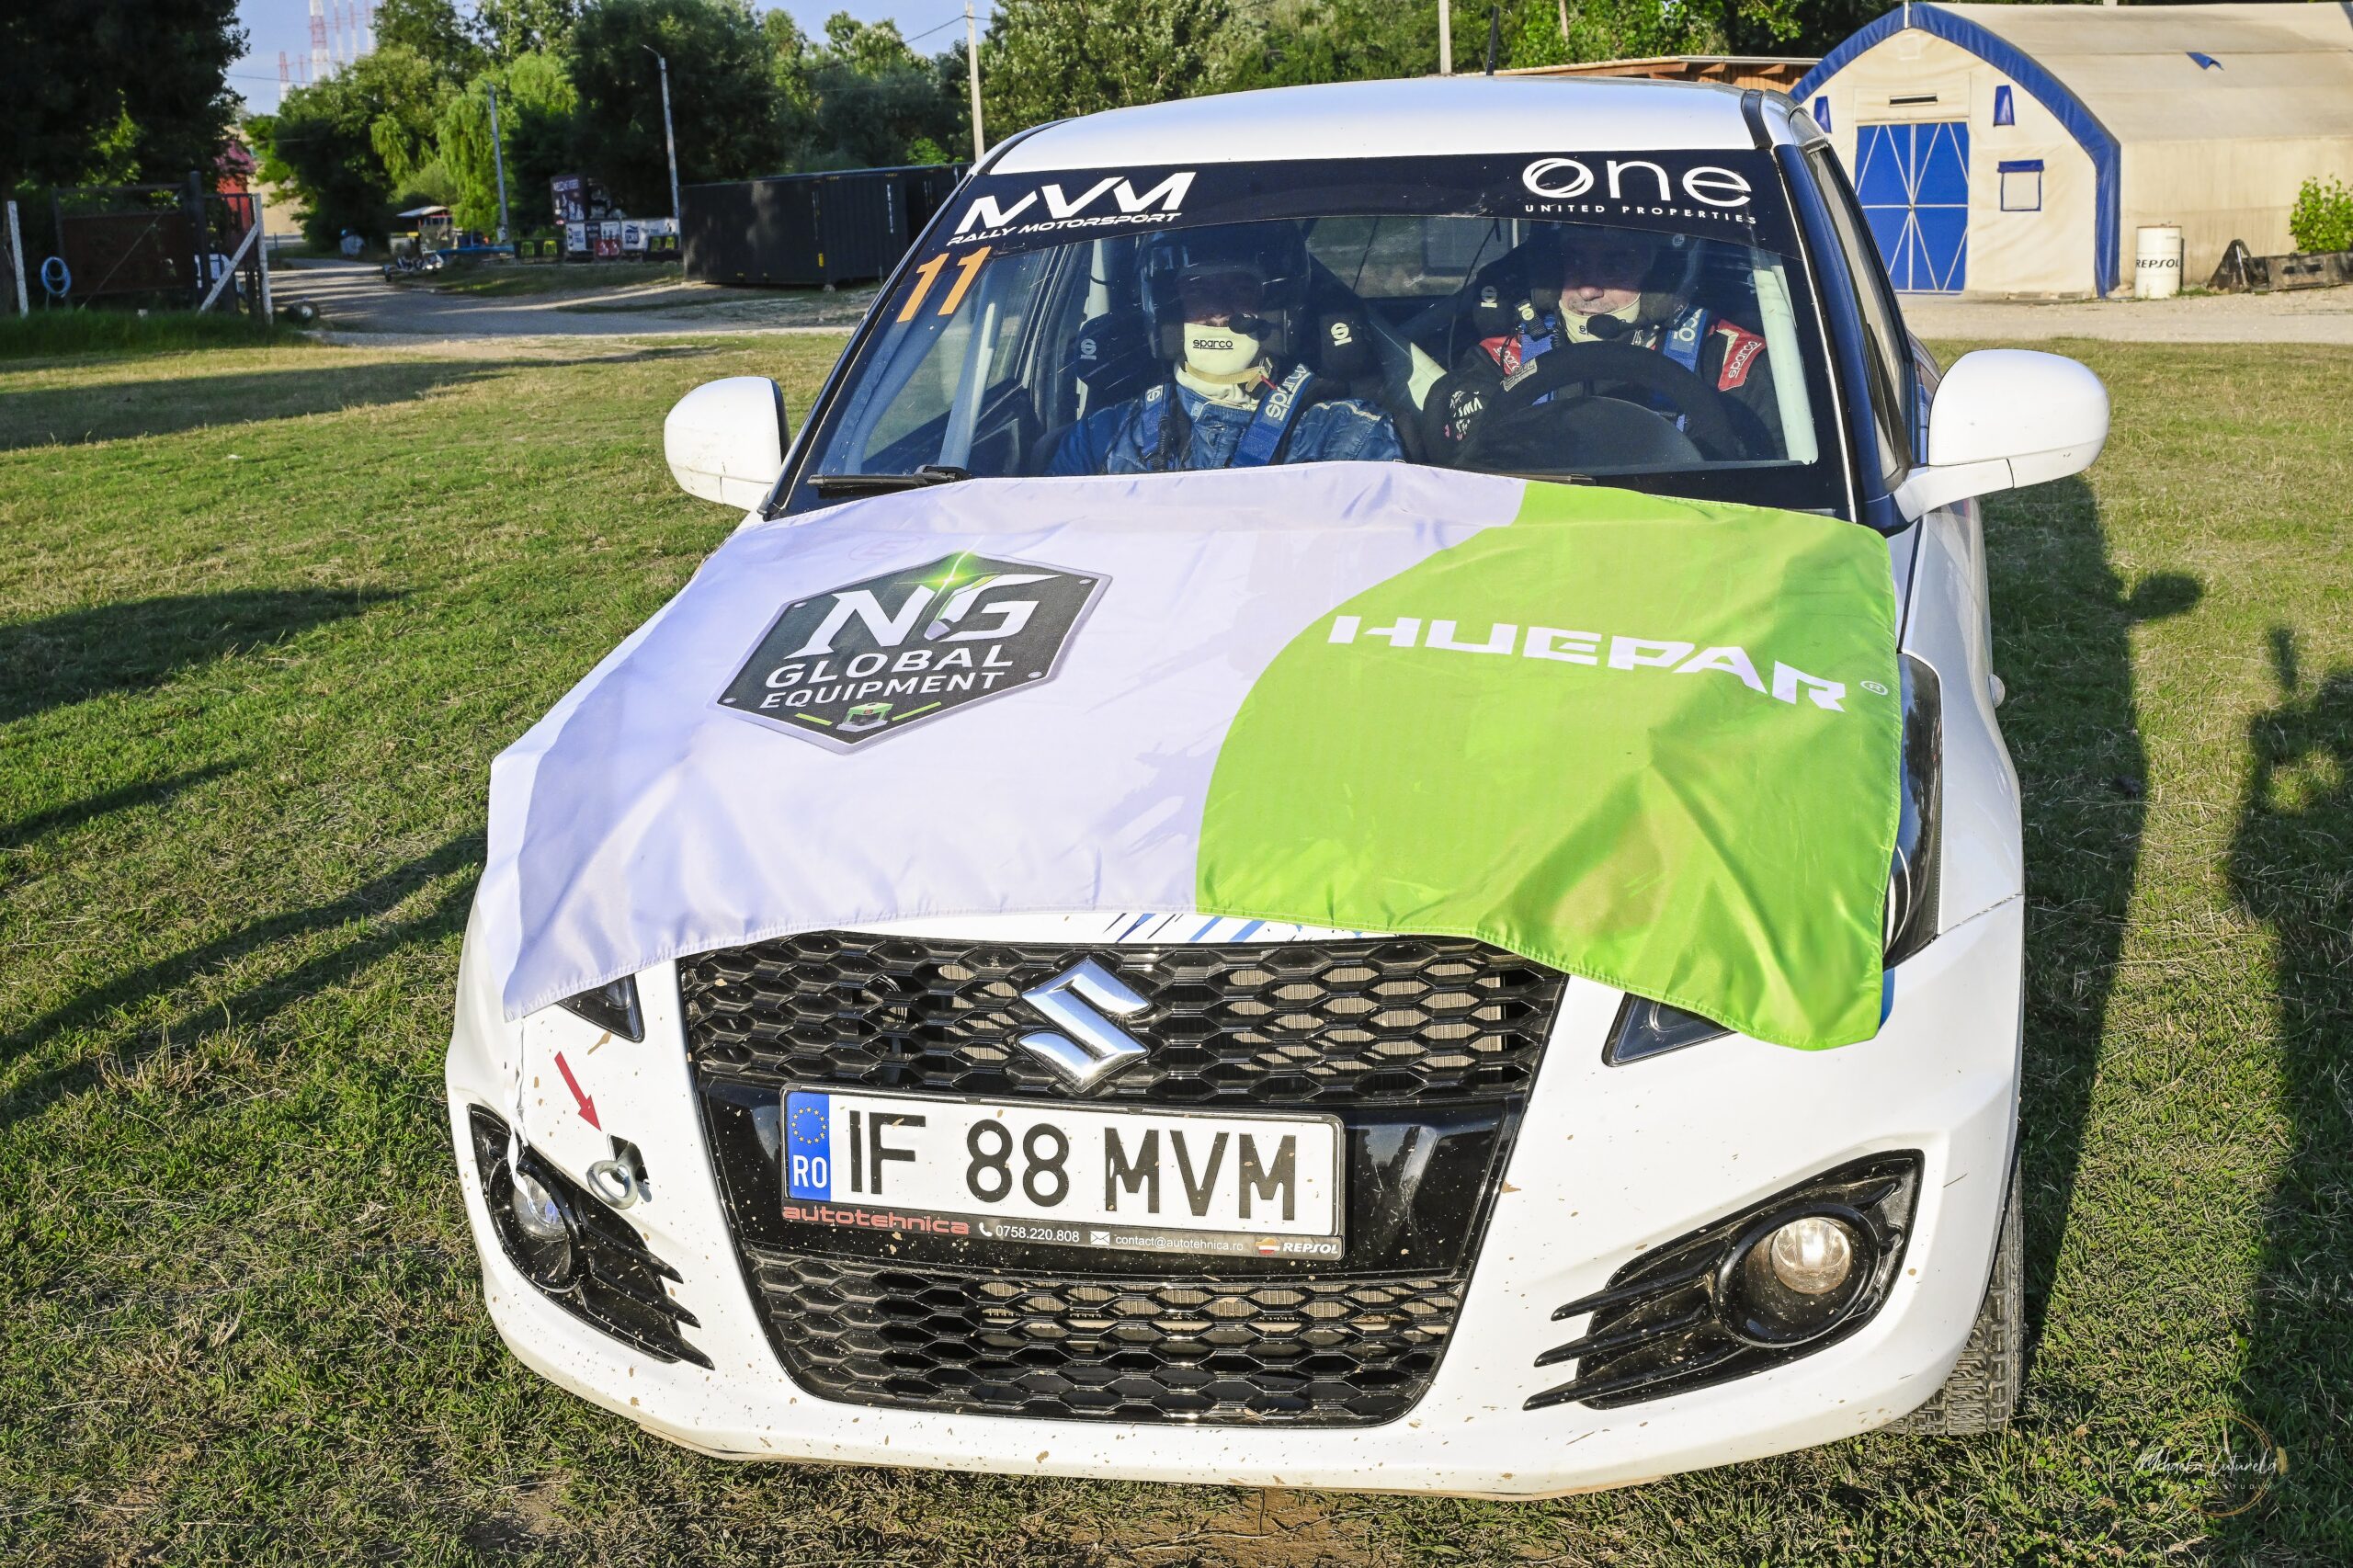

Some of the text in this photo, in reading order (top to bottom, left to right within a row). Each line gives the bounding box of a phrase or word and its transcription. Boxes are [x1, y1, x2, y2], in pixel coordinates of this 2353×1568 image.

[946, 212, 1182, 246] RALLY MOTORSPORT
[1525, 204, 1757, 224] UNITED PROPERTIES
[2135, 258, 2179, 268] REPSOL
[896, 246, 992, 322] 11
[1192, 338, 1233, 350] sparco
[1728, 341, 1761, 379] sparco
[783, 574, 1063, 659] NG
[766, 645, 1014, 688] GLOBAL
[1327, 615, 1846, 712] HUEPAR
[759, 672, 1005, 709] EQUIPMENT
[792, 1154, 828, 1189] RO
[848, 1110, 1297, 1221] IF 88 MVM
[783, 1206, 1339, 1256] autotehnica 0758.220.808 contact@autotehnica.ro REPSOL
